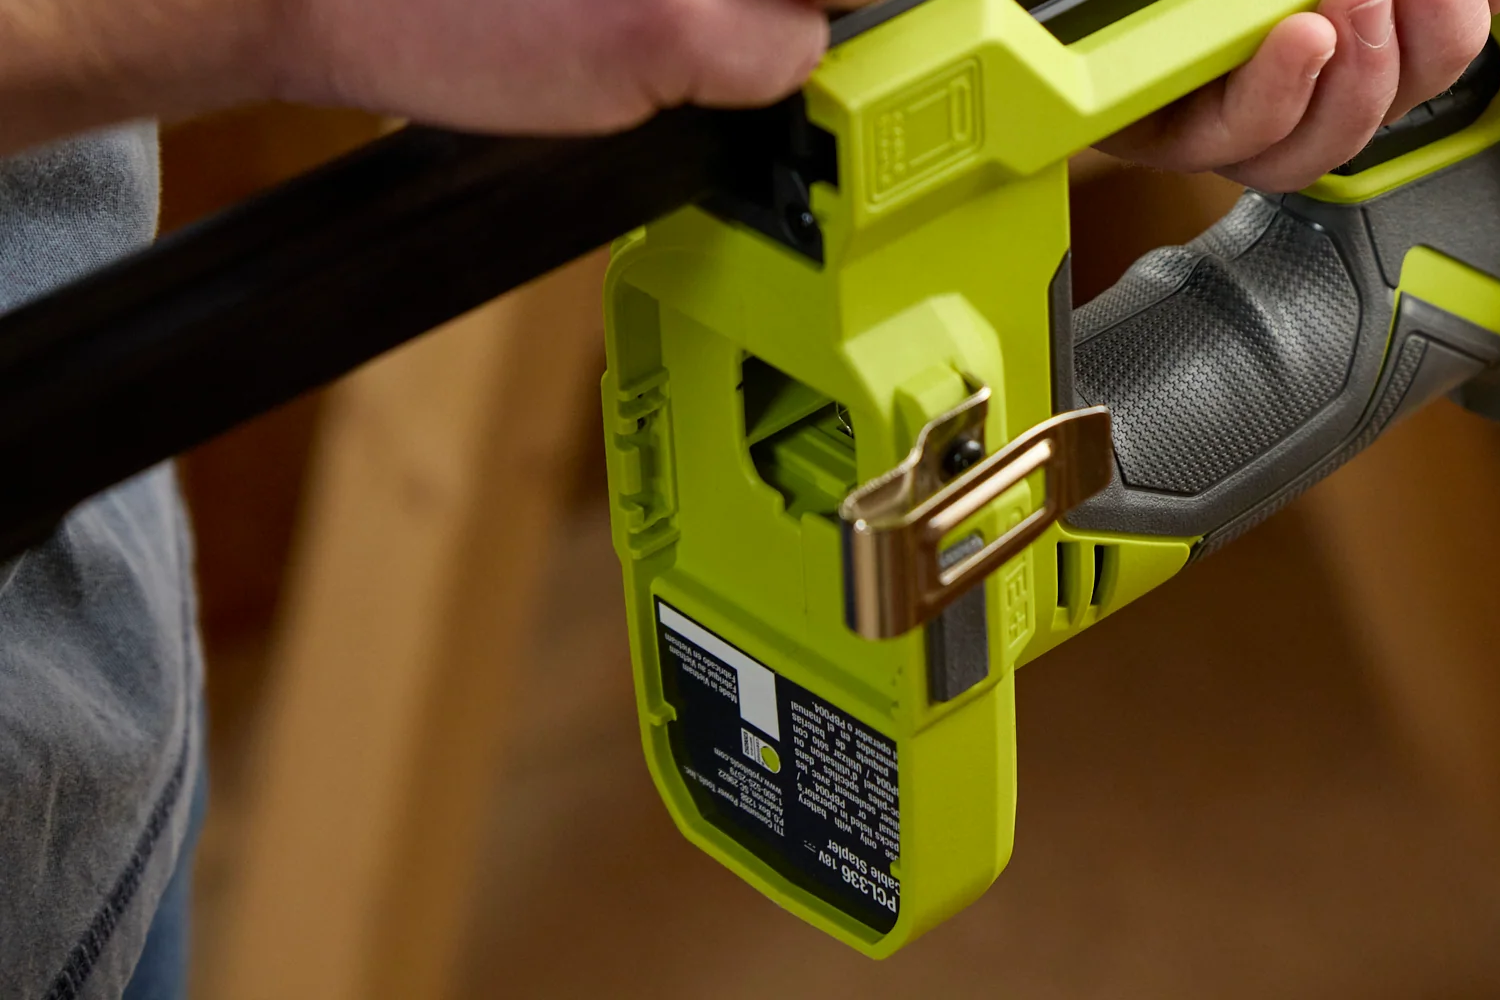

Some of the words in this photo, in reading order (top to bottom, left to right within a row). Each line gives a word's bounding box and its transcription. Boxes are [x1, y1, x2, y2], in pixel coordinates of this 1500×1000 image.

[665, 632, 692, 656] Vietnam
[669, 645, 696, 668] Vietnam
[693, 650, 701, 660] en
[682, 663, 709, 687] Vietnam
[697, 664, 706, 674] au
[703, 656, 736, 683] Fabricado
[711, 681, 717, 692] in
[719, 685, 737, 704] Made
[791, 701, 821, 724] manual
[793, 725, 808, 739] con
[827, 722, 835, 732] el
[840, 730, 850, 741] en
[847, 723, 853, 732] o
[794, 736, 804, 747] ou
[835, 739, 845, 750] de
[854, 728, 891, 754] operador
[795, 748, 814, 765] dans
[834, 749, 861, 773] Utilizar
[856, 751, 888, 776] paquete
[796, 760, 807, 774] les
[812, 770, 830, 786] avec
[717, 787, 738, 806] Power
[797, 783, 837, 813] operator's
[812, 781, 845, 808] PBP004.
[835, 784, 876, 814] seulement
[864, 779, 893, 802] manuel
[740, 801, 772, 828] Consumer
[758, 803, 771, 817] Box
[798, 794, 826, 819] battery
[868, 793, 899, 817] oc-piles
[840, 809, 848, 821] in
[857, 810, 866, 820] or
[773, 823, 784, 836] TTI
[835, 817, 852, 834] with
[851, 816, 872, 835] listed
[879, 823, 900, 840] anual
[860, 832, 877, 849] only
[875, 832, 899, 852] packs
[818, 850, 837, 870] 18V
[827, 839, 868, 874] Stapler
[842, 865, 896, 912] PCL336
[871, 866, 900, 895] Cable
